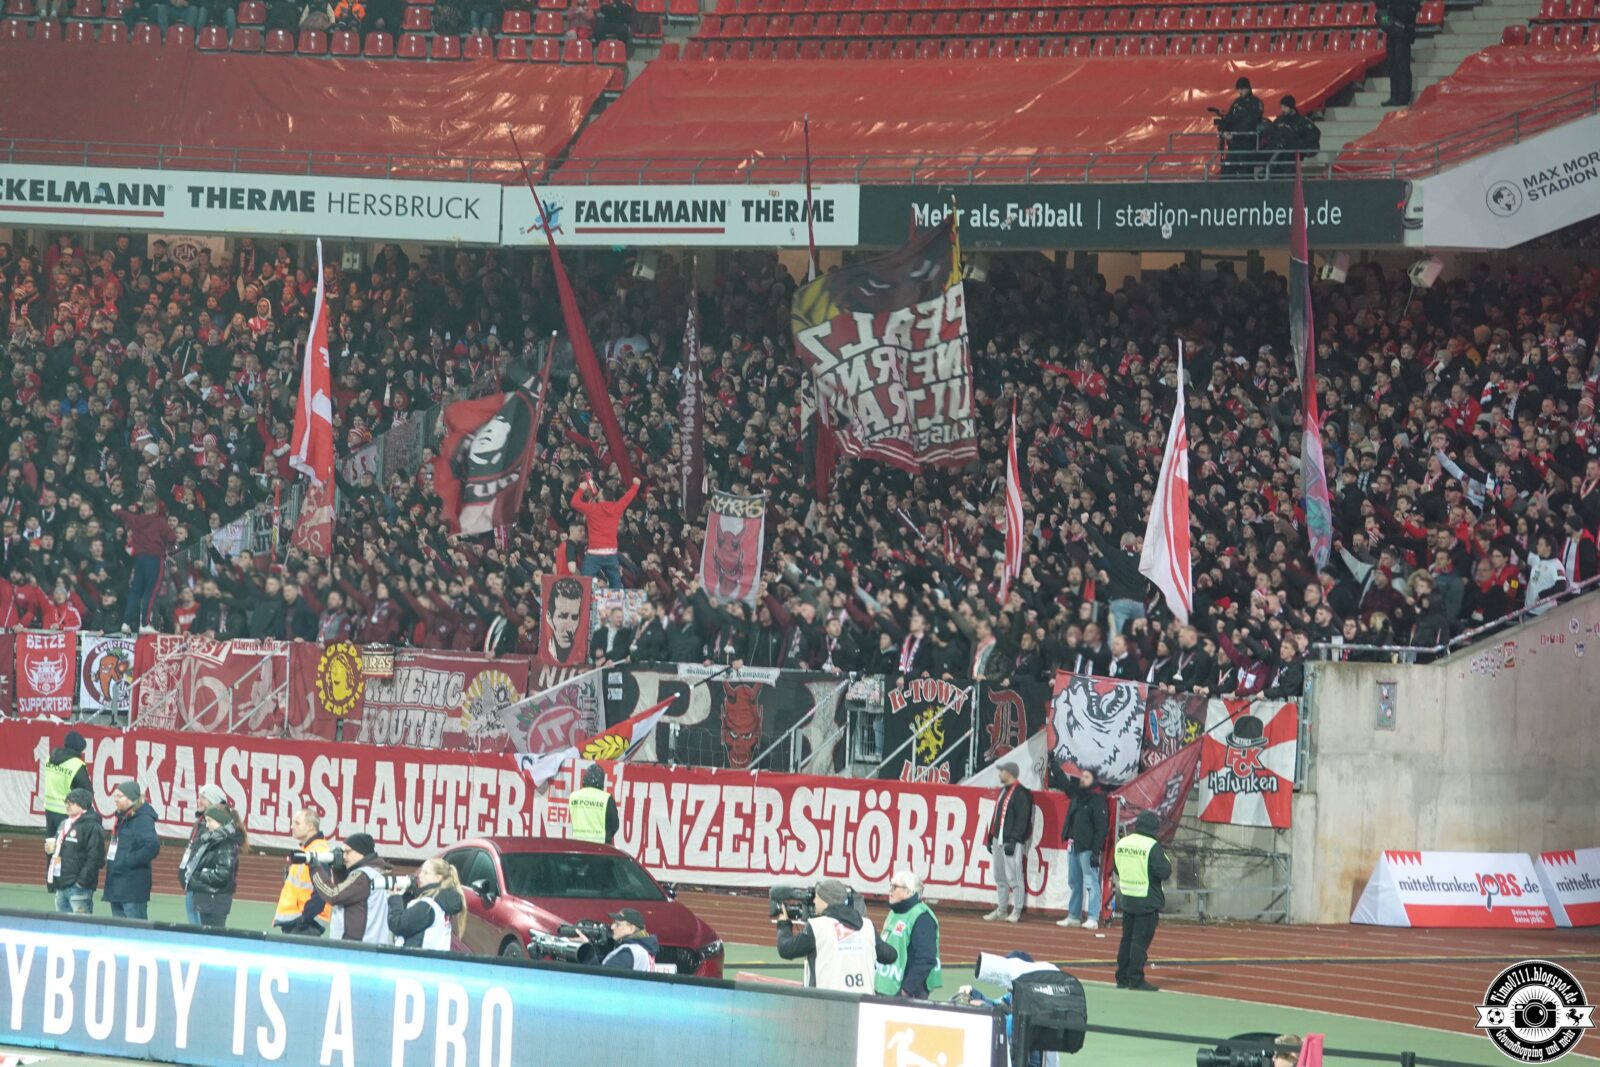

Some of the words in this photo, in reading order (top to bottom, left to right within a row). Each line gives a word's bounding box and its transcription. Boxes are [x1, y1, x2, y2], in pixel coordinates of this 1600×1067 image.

[1522, 166, 1560, 190] MAX
[1527, 167, 1598, 202] STADION
[187, 185, 316, 213] THERME
[327, 192, 480, 220] HERSBRUCK
[575, 200, 726, 223] FACKELMANN
[742, 200, 834, 223] THERME
[970, 202, 999, 227] als
[1006, 202, 1083, 229] Fußball
[26, 634, 66, 649] BETZE
[19, 697, 72, 712] SUPPORTERS
[358, 705, 446, 748] YOUTH
[135, 738, 575, 850] KAISERSLAUTERN
[1209, 769, 1277, 795] Halunken
[845, 973, 864, 988] 08
[231, 961, 291, 1061] IS
[319, 972, 355, 1067] A
[390, 977, 515, 1067] PRO
